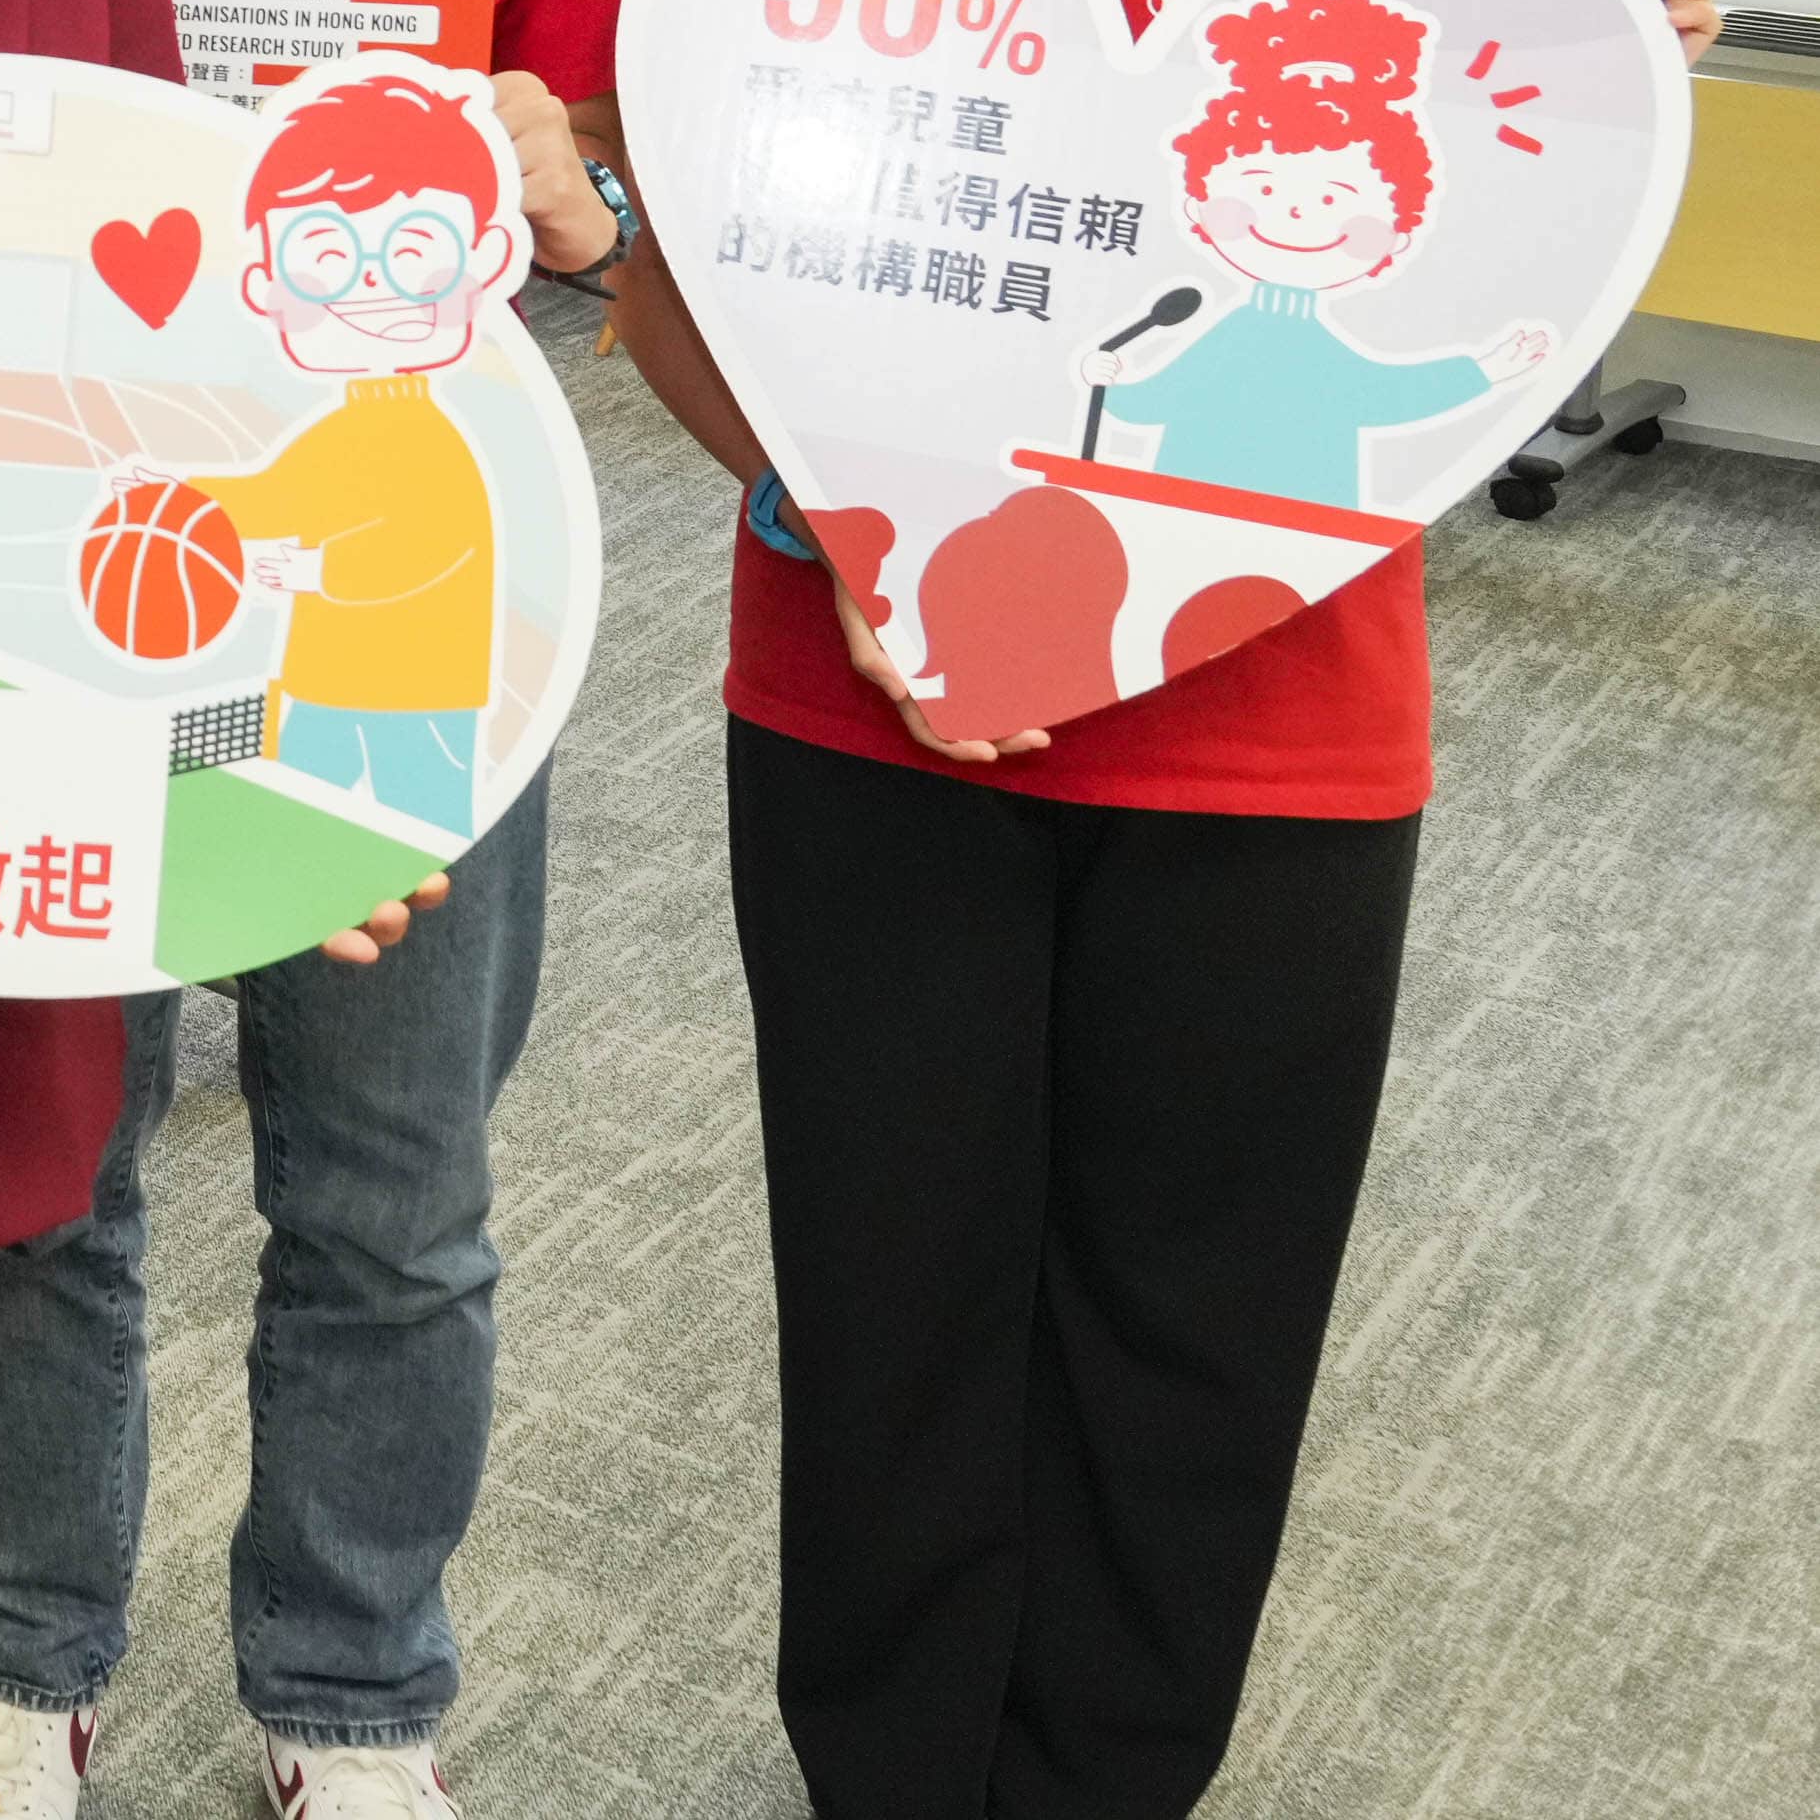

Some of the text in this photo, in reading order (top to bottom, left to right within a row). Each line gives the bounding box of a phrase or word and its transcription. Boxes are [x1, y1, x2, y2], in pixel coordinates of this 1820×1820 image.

[295, 9, 311, 27] IN
[317, 11, 364, 30] HONG
[371, 14, 417, 33] KONG
[199, 35, 284, 56] RESEARCH
[291, 39, 345, 59] STUDY
